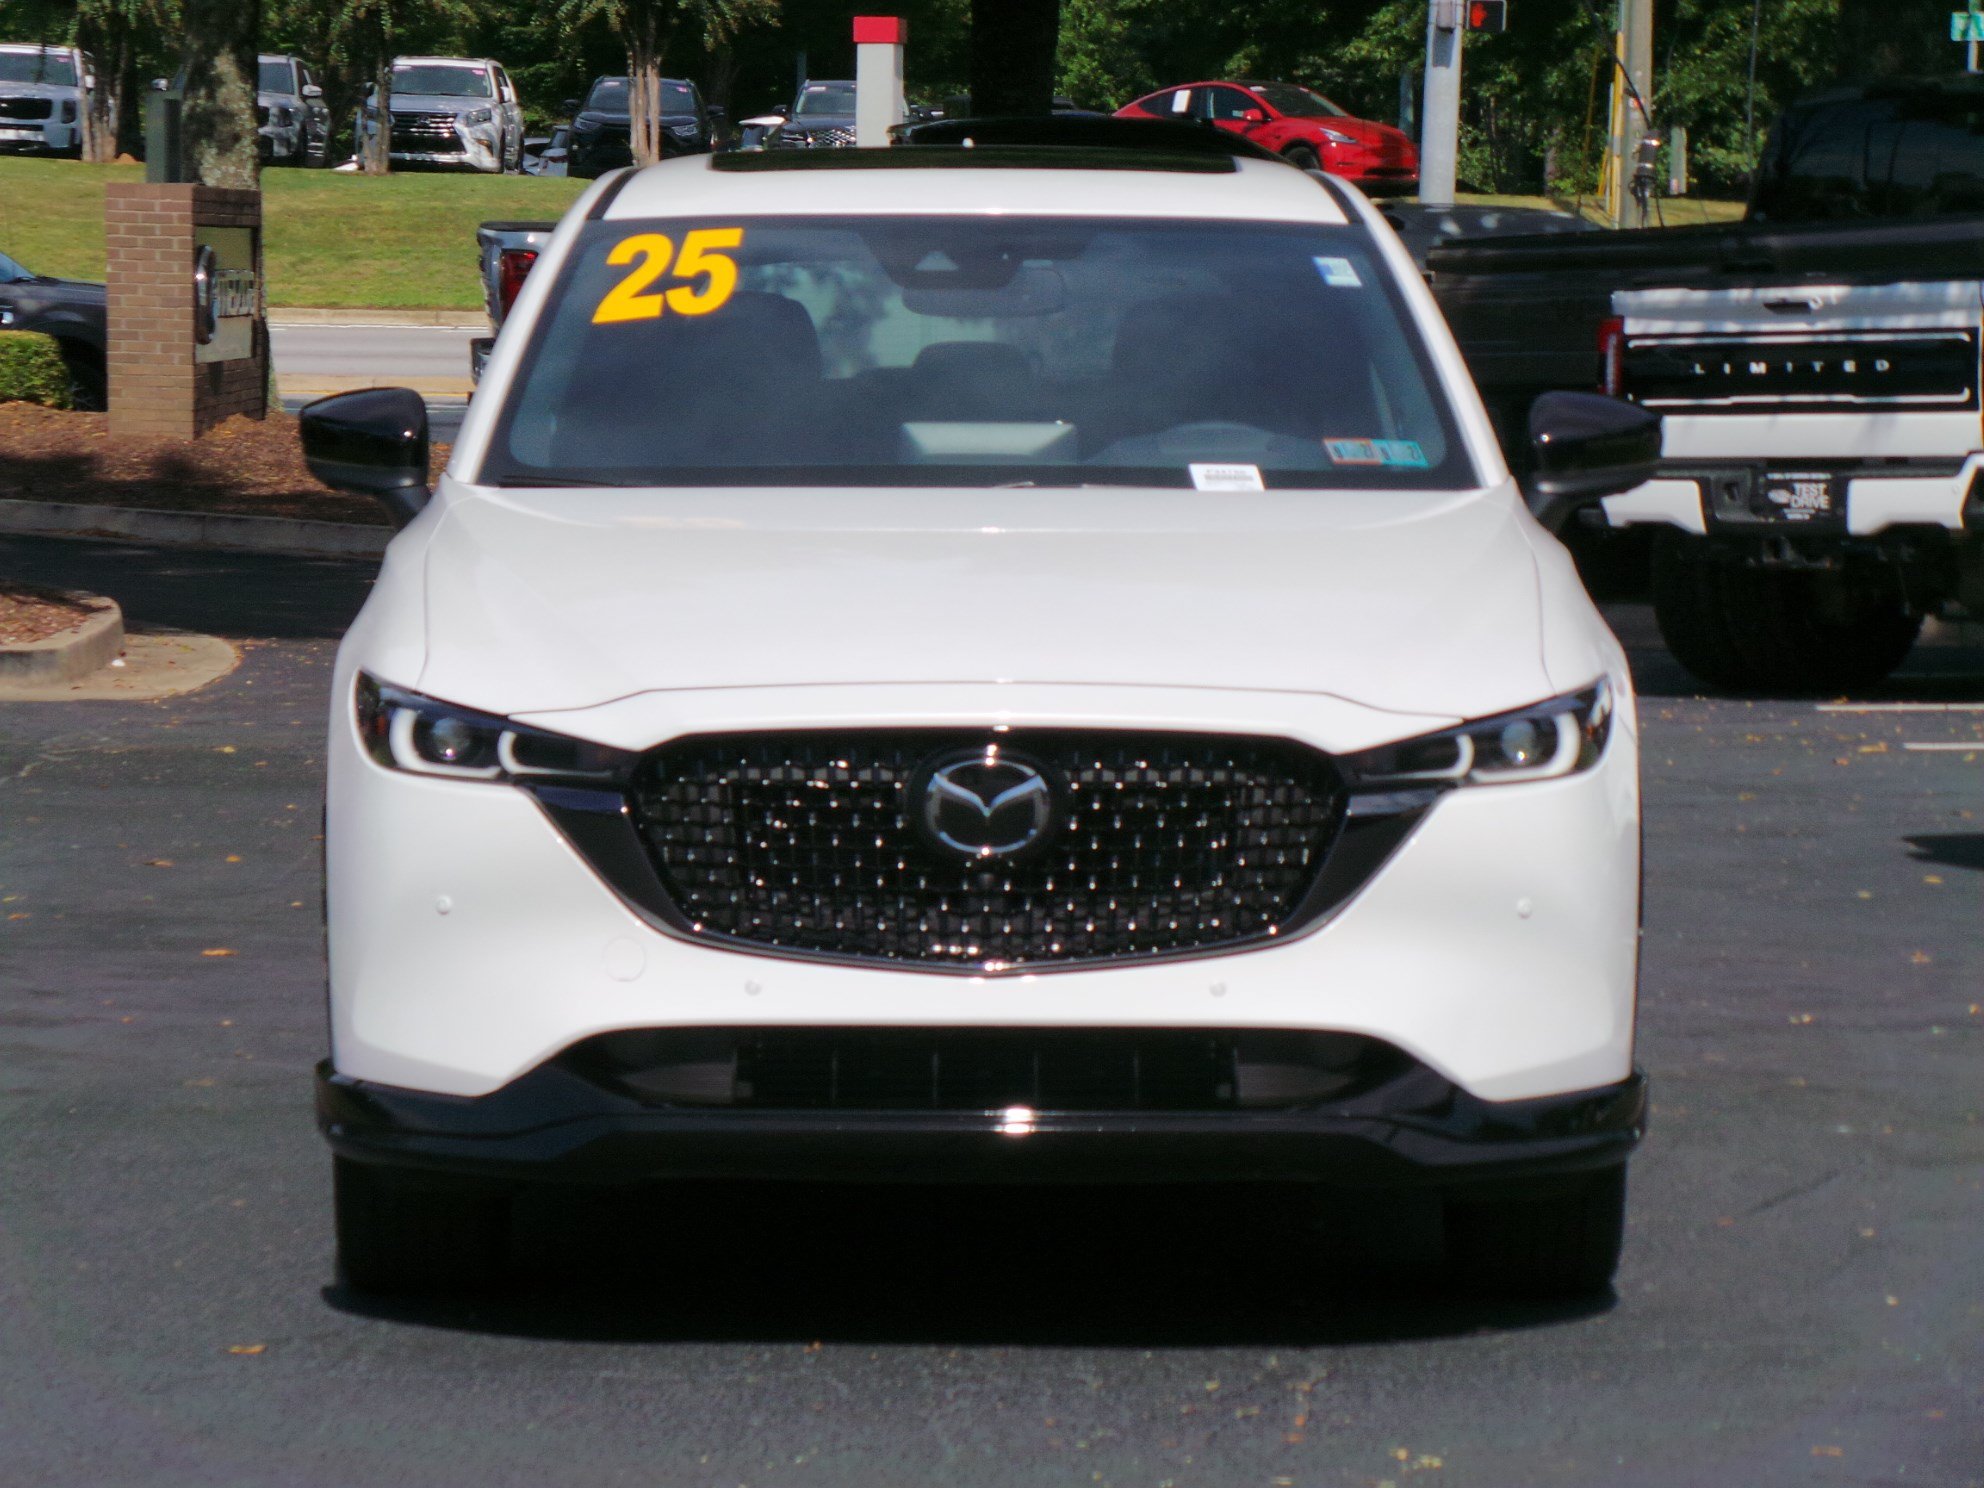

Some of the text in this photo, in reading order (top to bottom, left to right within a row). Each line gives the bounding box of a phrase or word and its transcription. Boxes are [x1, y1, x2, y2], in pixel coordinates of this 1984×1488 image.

[592, 227, 744, 324] 25
[1694, 359, 1890, 375] LIMITED
[1793, 482, 1828, 496] TEST
[1790, 495, 1831, 509] DRIVE
